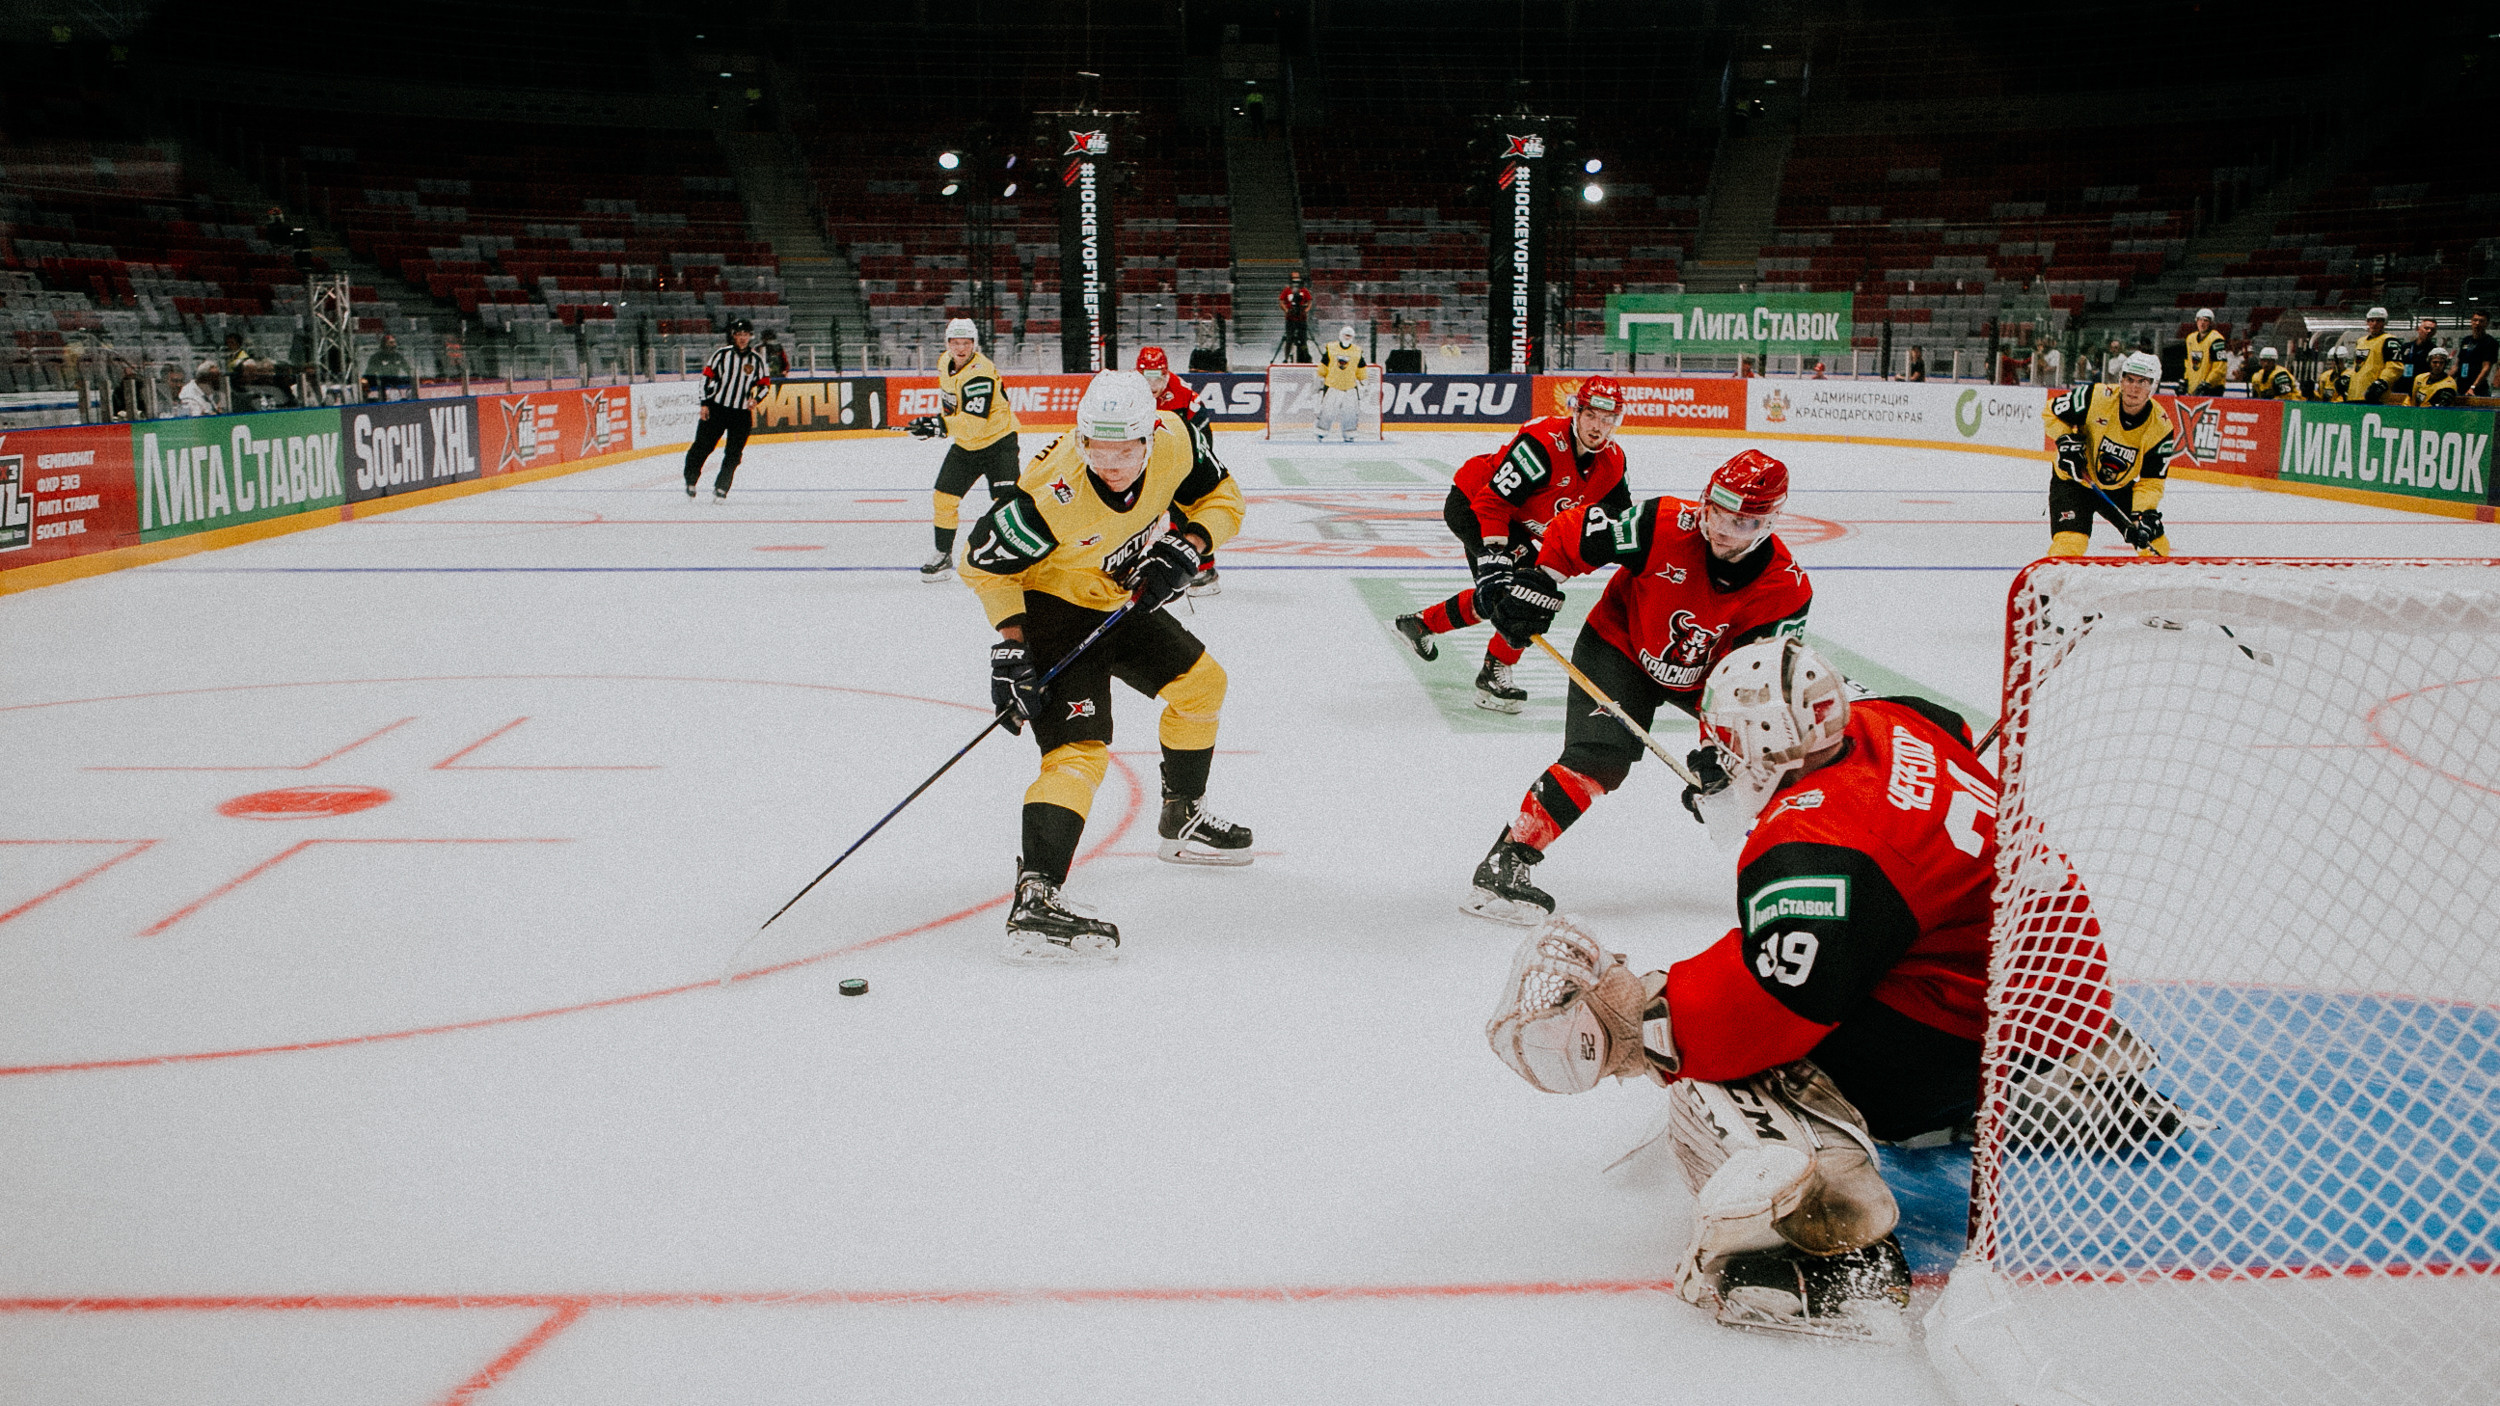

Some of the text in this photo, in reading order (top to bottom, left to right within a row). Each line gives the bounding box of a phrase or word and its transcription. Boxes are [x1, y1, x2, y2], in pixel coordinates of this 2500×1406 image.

[1620, 386, 1695, 402] ЕДЕРАЦИЯ
[1813, 391, 1910, 406] АДМИНИСТРАЦИЯ
[1103, 400, 1117, 412] 17
[1622, 402, 1665, 417] ОККЕЯ
[1668, 404, 1730, 419] РОССИИ
[1795, 407, 1923, 423] КРАСНОДАРСКОГО КРАЯ
[1988, 398, 2033, 423] Сириус
[429, 405, 476, 478] XHL
[37, 450, 95, 470] ЧЕМПИОНАТ
[2100, 439, 2137, 464] РОСТОВ
[1493, 461, 1522, 497] 92
[63, 494, 100, 513] СТАВОК
[36, 521, 67, 541] SOCHI
